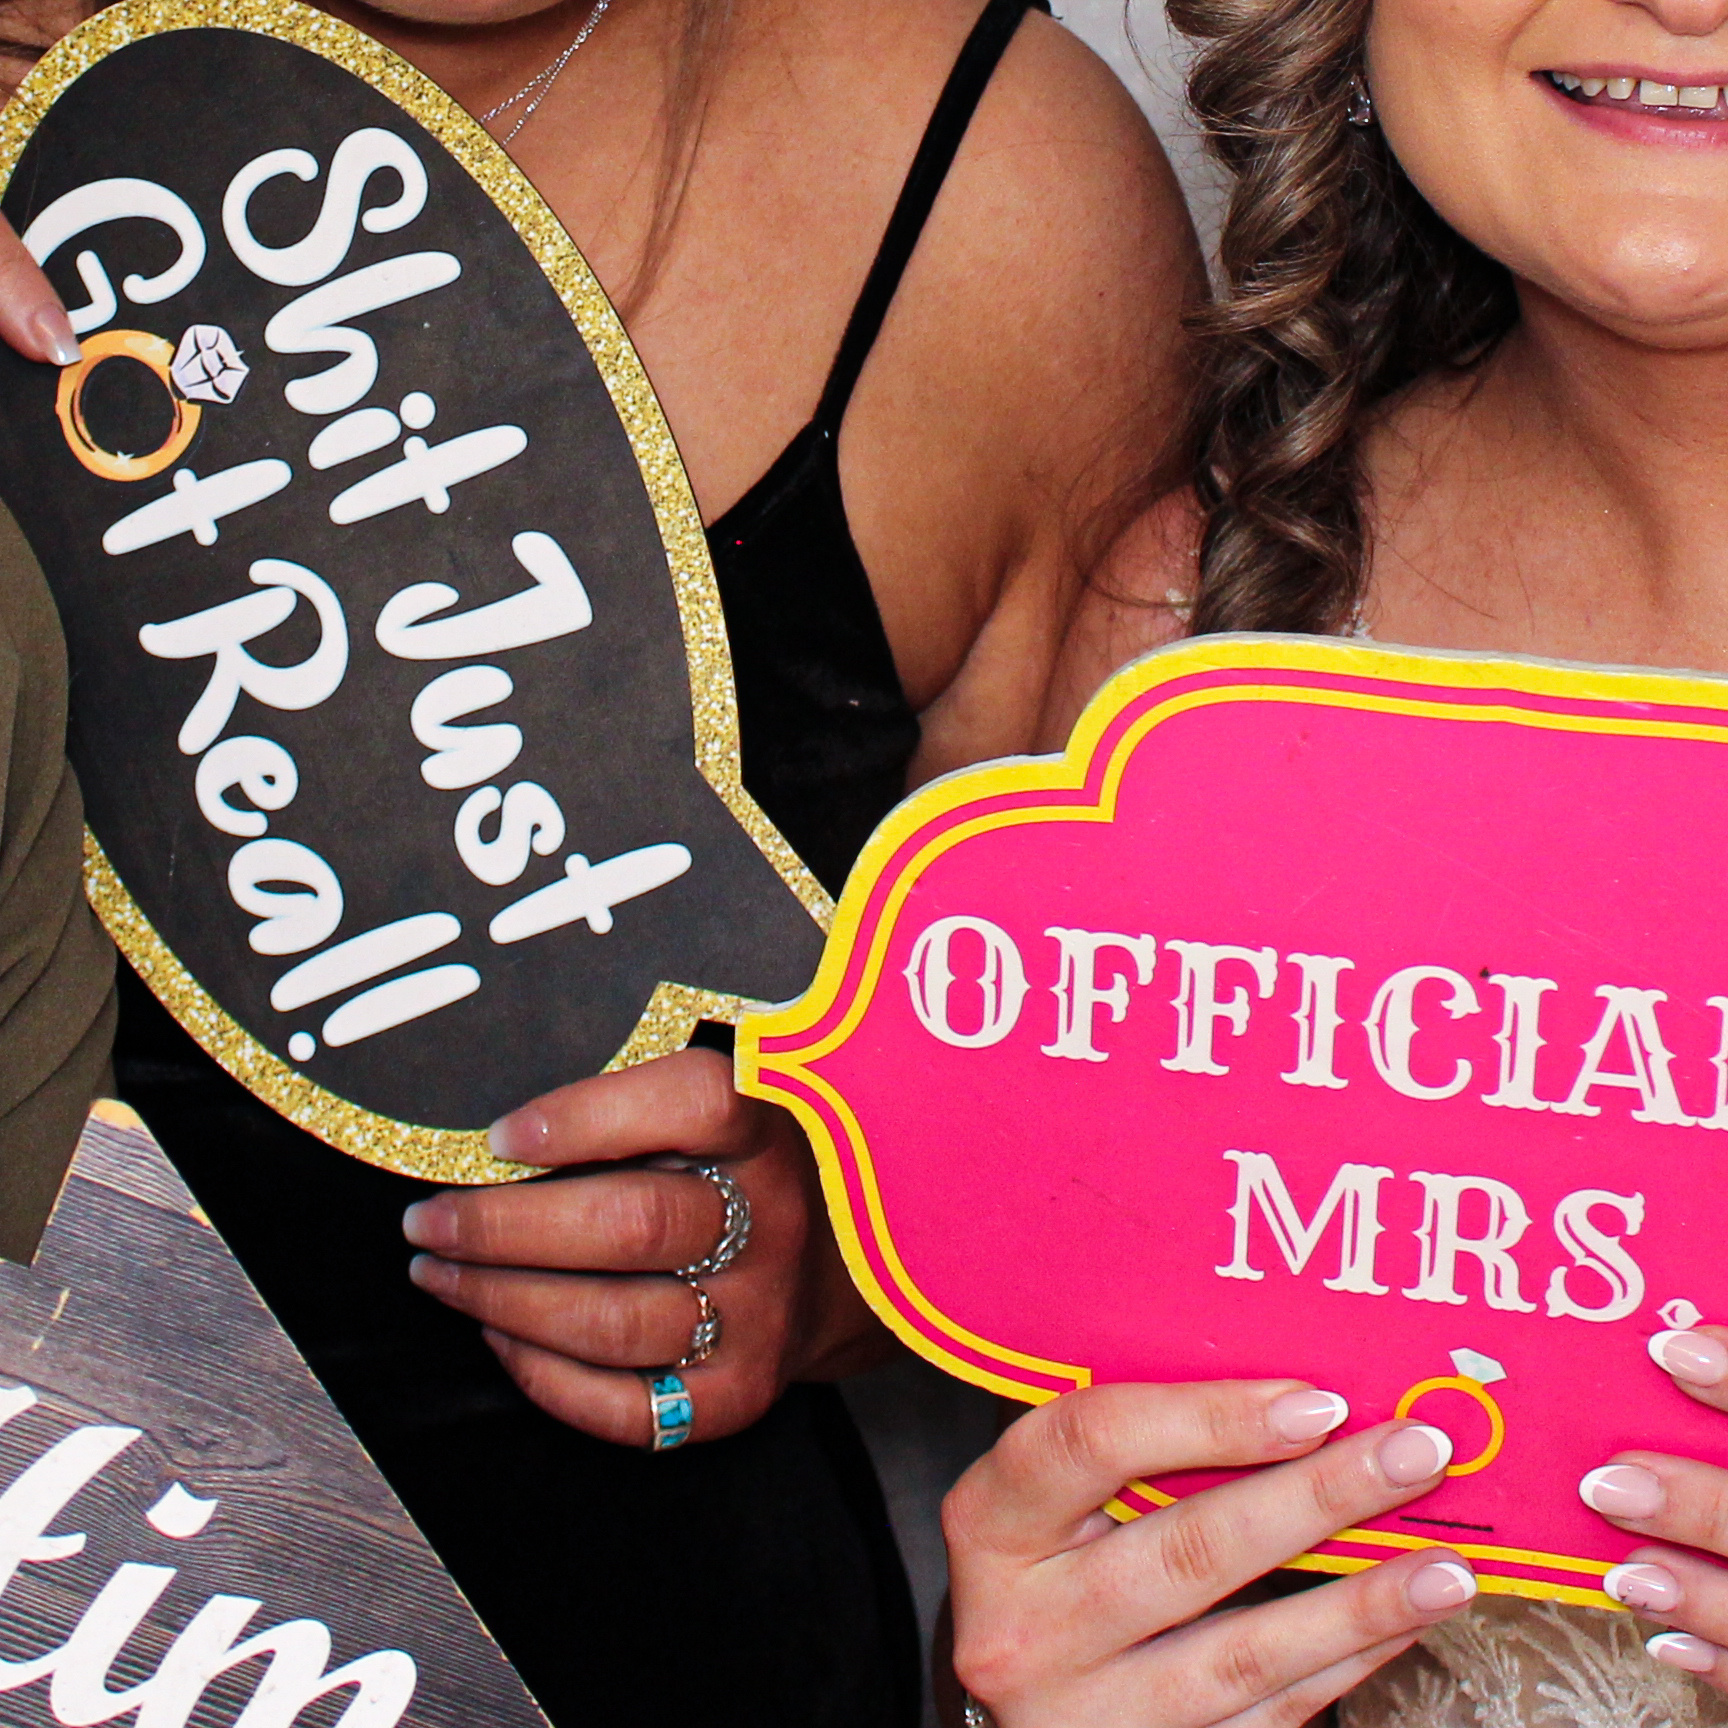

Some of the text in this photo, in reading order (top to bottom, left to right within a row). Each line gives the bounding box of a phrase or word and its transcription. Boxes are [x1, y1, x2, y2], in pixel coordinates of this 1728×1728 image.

[221, 127, 693, 945] Shit Just
[137, 558, 482, 1063] Real!
[1214, 1148, 1703, 1330] MRS.
